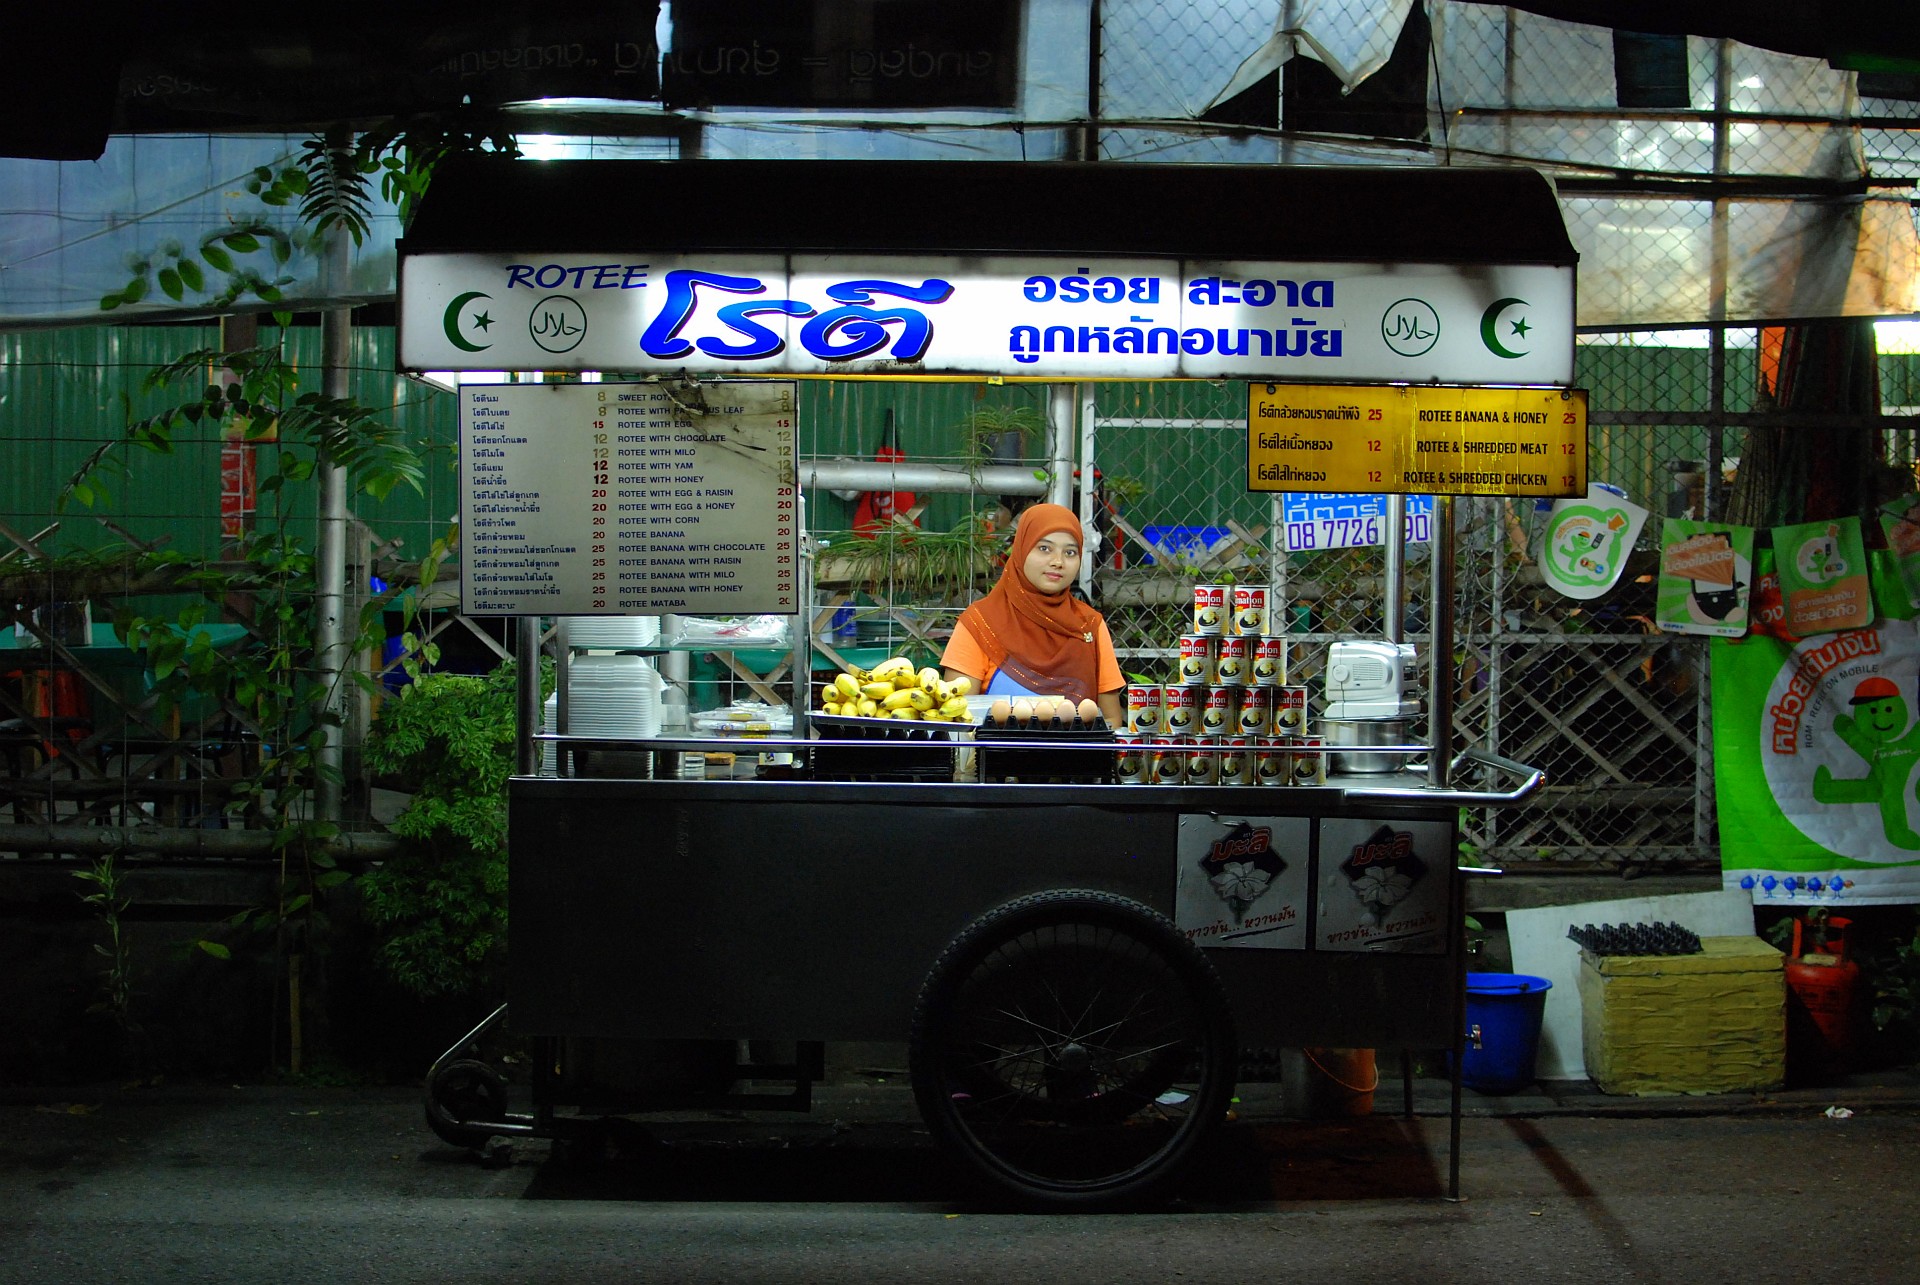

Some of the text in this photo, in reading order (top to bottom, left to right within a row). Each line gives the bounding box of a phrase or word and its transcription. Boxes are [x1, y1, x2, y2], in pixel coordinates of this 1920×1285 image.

[505, 264, 650, 290] ROTEE
[1023, 267, 1335, 308] อร่อย สะอาด
[639, 268, 956, 363] โรตี
[533, 311, 583, 338] حلال
[1385, 314, 1436, 341] حلال
[1009, 315, 1343, 363] ถูกหลักอนามัย
[617, 394, 647, 402] SWEET
[782, 390, 790, 401] 8
[617, 408, 646, 416] ROTEE
[723, 406, 745, 414] LEAF
[1368, 409, 1383, 421] 25
[1419, 410, 1548, 424] ROTEE BANANA & HONEY
[1563, 413, 1577, 424] 25
[592, 420, 605, 430] 15
[617, 418, 693, 429] ROTEE WITH EGG
[776, 419, 790, 428] 15
[593, 433, 608, 445] 12
[617, 434, 727, 443] ROTEE WITH CHOCOLATE
[777, 431, 792, 442] 12
[1367, 440, 1382, 451] 12
[1417, 441, 1548, 455] ROTEE & SHREDDED MEAT
[1562, 444, 1575, 455] 12
[592, 447, 609, 459] 12
[617, 448, 696, 457] ROTEE WITH MILO
[777, 446, 792, 456] 12
[592, 459, 609, 472] 12
[618, 462, 694, 471] ROTEE WITH YAM
[777, 459, 792, 470] 12
[593, 473, 609, 485] 12
[618, 475, 705, 484] ROTEE WITH HONEY
[777, 473, 792, 484] 12
[1367, 471, 1382, 482] 12
[1403, 471, 1547, 486] ROTEE & SHREDDED CHICKEN
[1562, 476, 1575, 487] 12
[591, 489, 607, 498] 20
[618, 488, 734, 498] ROTEE WITH EGG & RAISIN
[777, 487, 793, 497] 20
[591, 503, 607, 512] 20
[618, 502, 736, 512] ROTEE WITH EGG & HONEY
[776, 500, 793, 510] 20
[592, 517, 606, 526] 20
[618, 516, 700, 525] ROTEE WITH CORN
[777, 513, 791, 523] 20
[592, 531, 606, 540] 20
[618, 530, 686, 539] ROTEE BANANA
[777, 527, 791, 536] 20
[1287, 522, 1316, 551] 08
[1322, 517, 1379, 548] 7726
[591, 544, 606, 553] 25
[618, 543, 766, 553] ROTEE BANANA WITH CHOCOLATE
[776, 541, 791, 551] 25
[592, 558, 606, 567] 25
[618, 557, 742, 567] ROTEE BANANA WITH RAISIN
[776, 555, 791, 564] 25
[592, 572, 606, 581] 25
[618, 570, 735, 580] ROTEE BANANA WITH MILO
[777, 569, 791, 578] 25
[592, 585, 606, 595] 25
[619, 584, 744, 594] ROTEE BANANA WITH HONEY
[777, 583, 791, 592] 25
[592, 599, 606, 608] 20
[619, 599, 687, 608] ROTEE MATABA
[778, 597, 791, 606] 20
[1825, 676, 1839, 690] ON
[1839, 664, 1879, 680] MOBILE
